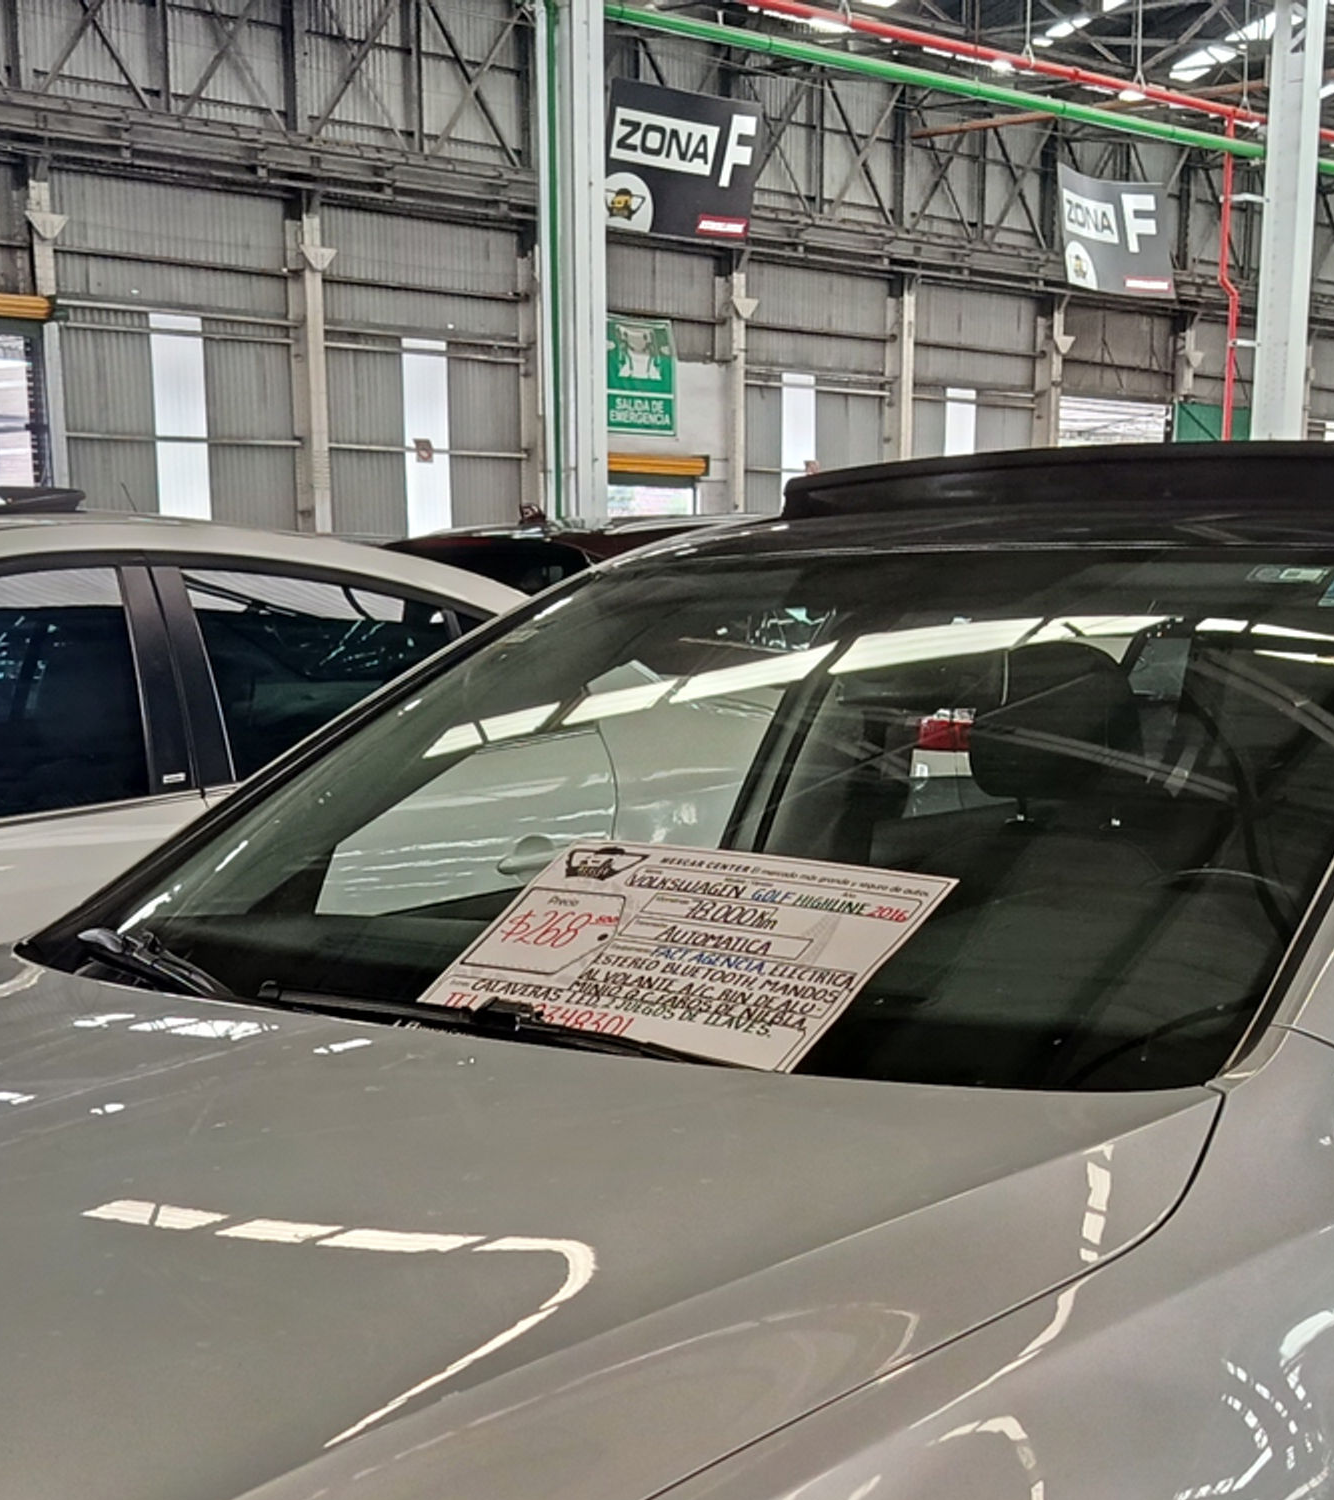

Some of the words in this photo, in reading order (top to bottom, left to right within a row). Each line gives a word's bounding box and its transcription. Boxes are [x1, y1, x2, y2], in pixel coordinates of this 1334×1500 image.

[615, 118, 709, 165] ZONA
[718, 114, 757, 188] F
[1066, 199, 1114, 235] ZONA
[1121, 193, 1157, 254] F
[609, 409, 671, 425] EMERGENCIA
[615, 398, 650, 411] SALIDA
[650, 400, 665, 413] DE
[706, 861, 751, 874] CENTER
[547, 895, 579, 907] Precio
[627, 874, 748, 899] VOLKSWAGEN
[751, 887, 796, 904] GOLF
[868, 905, 911, 923] 2016
[654, 925, 772, 955] AUTOMATICA
[471, 978, 564, 1001] CALAVERAS
[593, 953, 661, 975] ESTEREO
[759, 979, 841, 1004] MANDOS
